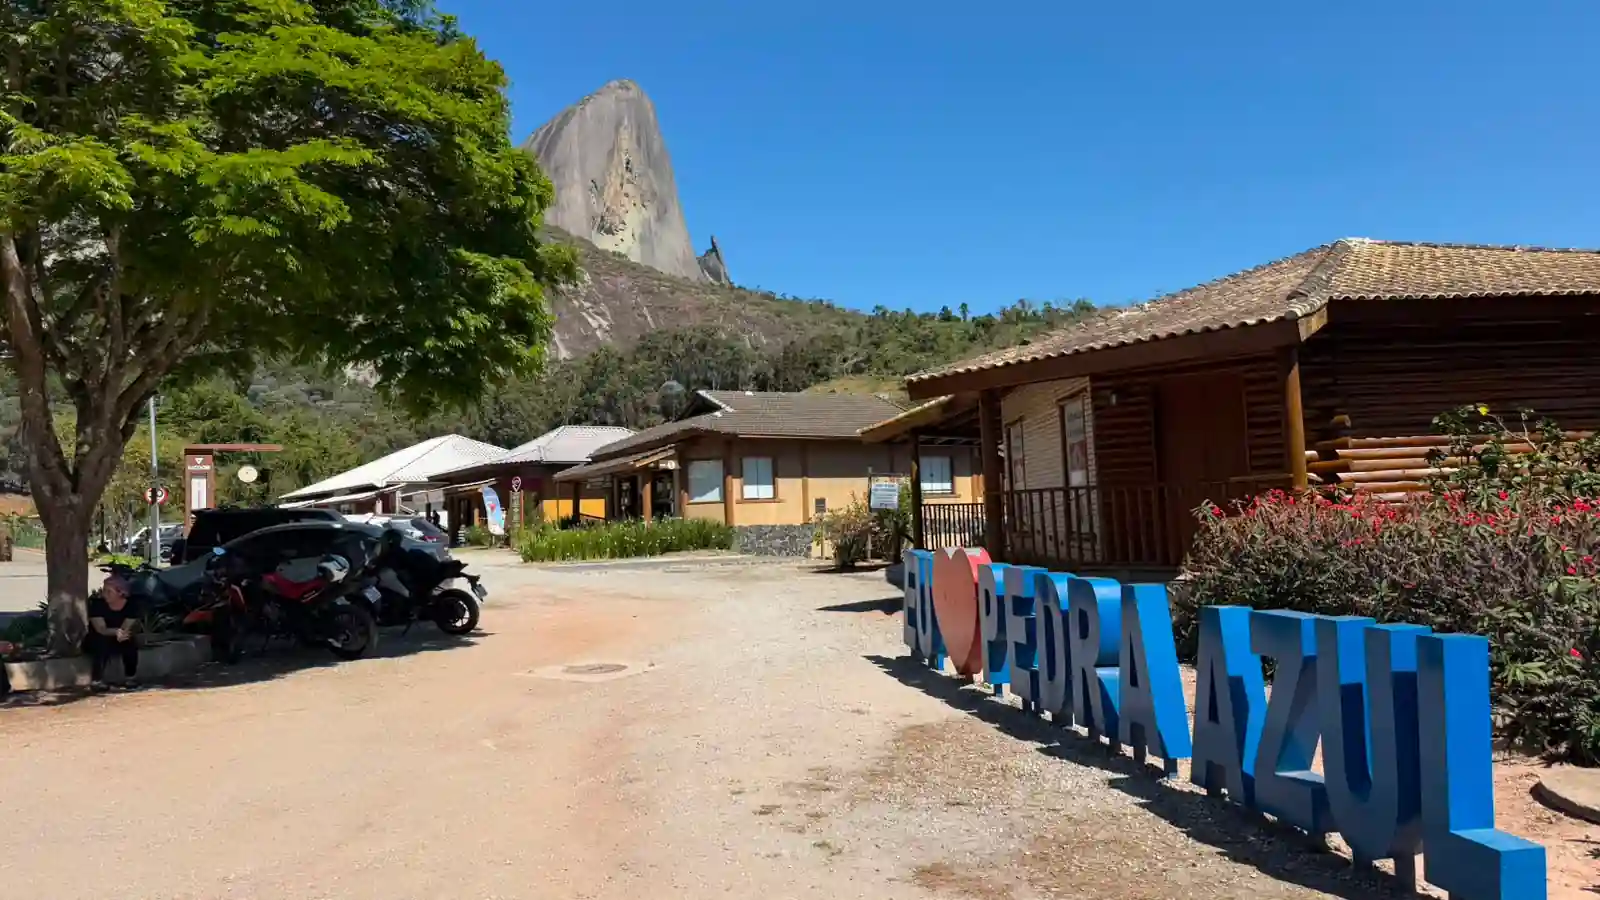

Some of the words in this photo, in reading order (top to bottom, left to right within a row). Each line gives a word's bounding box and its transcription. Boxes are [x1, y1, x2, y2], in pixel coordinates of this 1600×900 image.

[903, 549, 934, 657] EU
[977, 563, 1190, 768] PEDRA
[1191, 604, 1546, 900] AZUL
